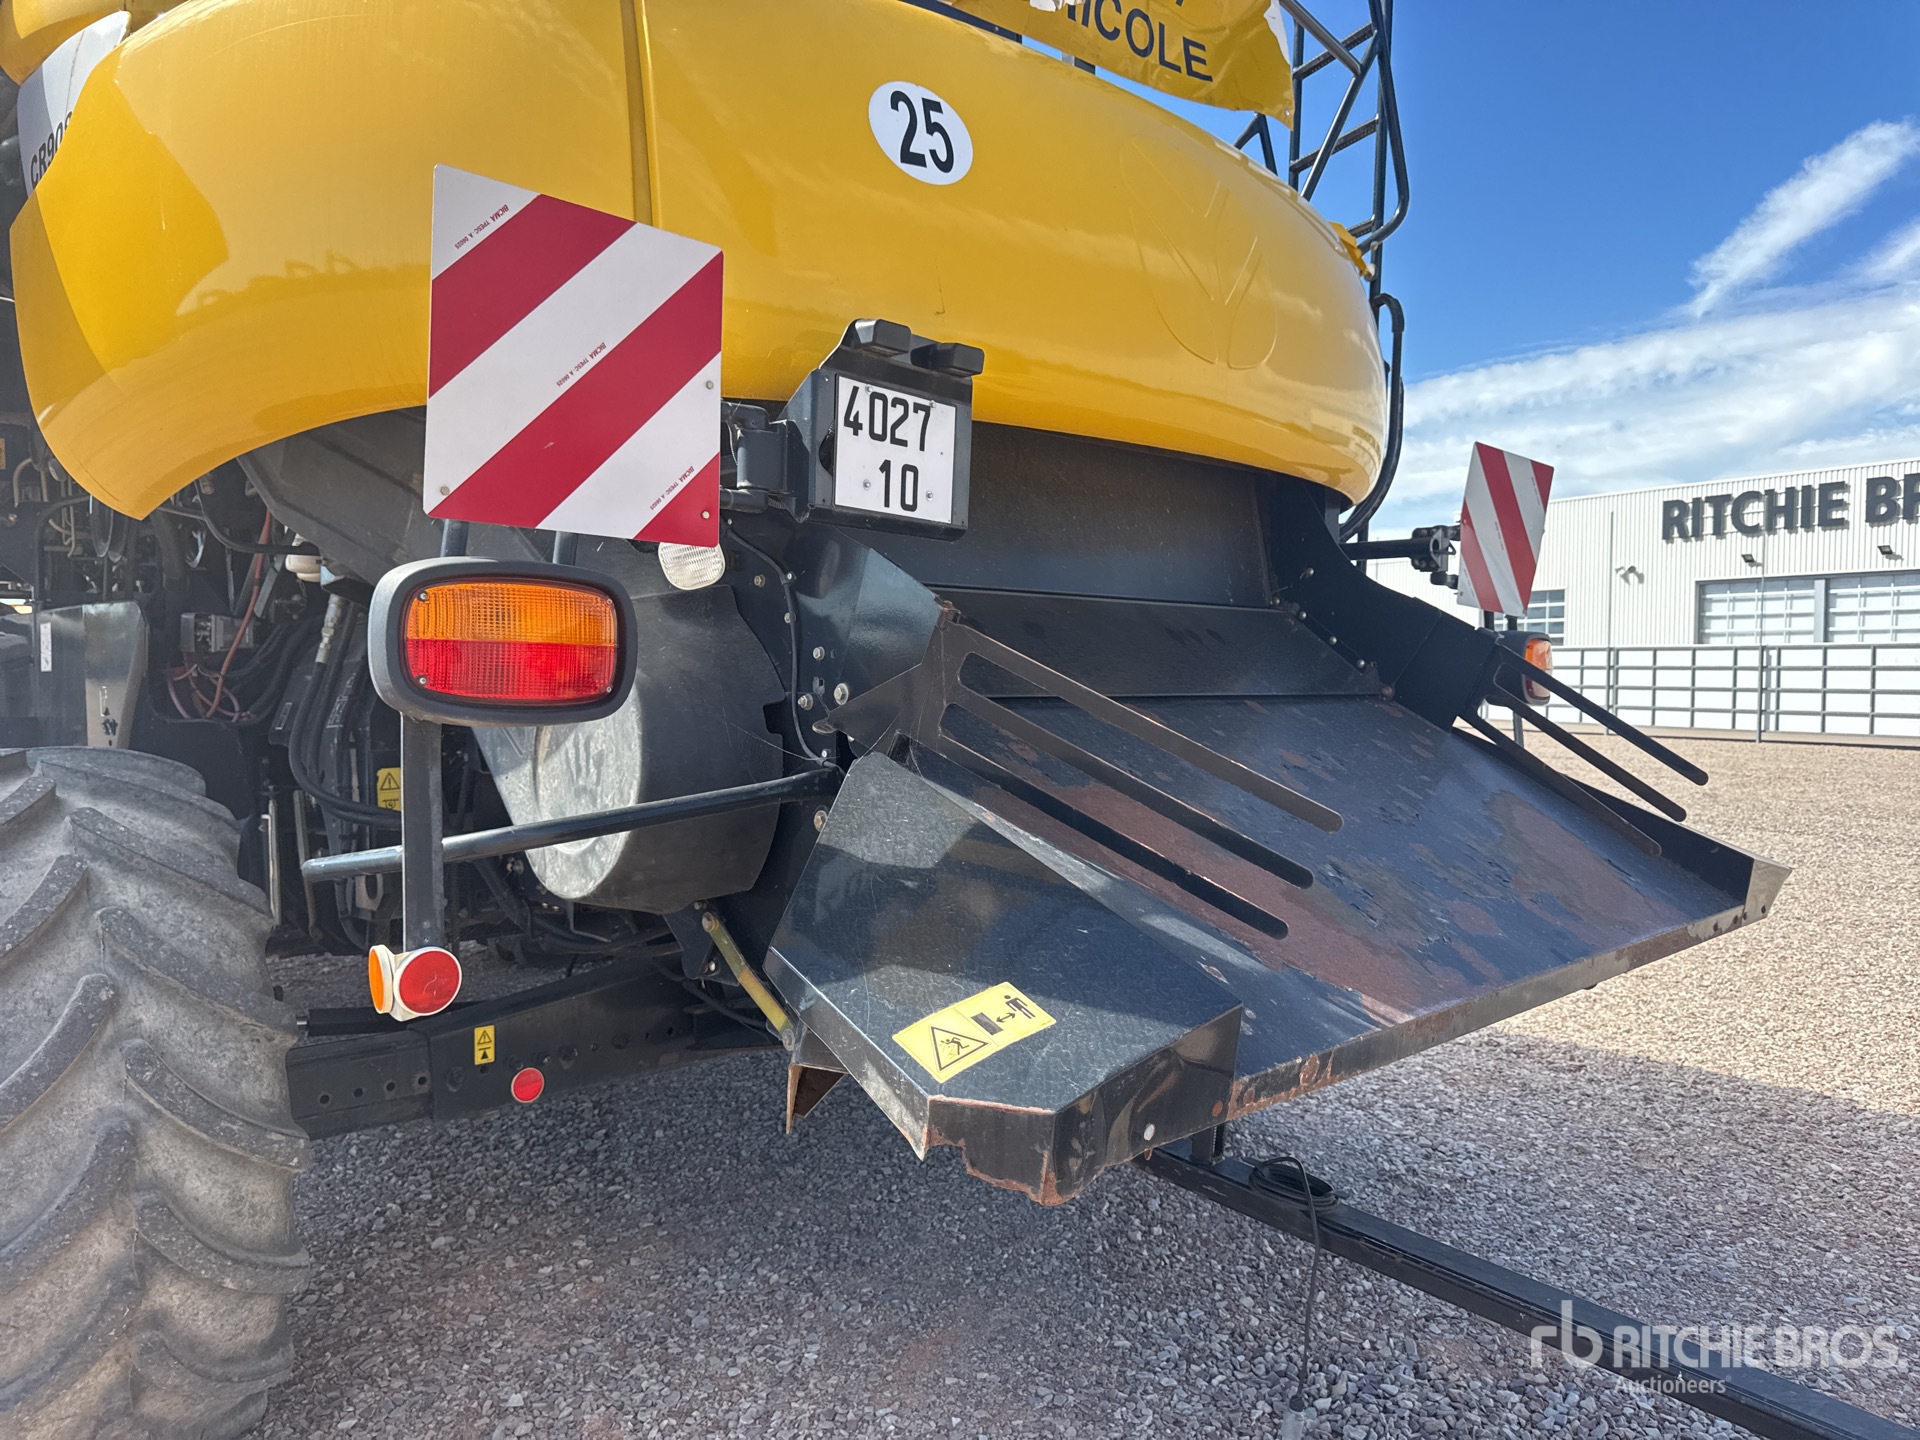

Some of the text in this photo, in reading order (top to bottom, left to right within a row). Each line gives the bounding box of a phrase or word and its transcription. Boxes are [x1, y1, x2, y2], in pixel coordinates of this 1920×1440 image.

[1067, 0, 1213, 82] ICOLE
[890, 90, 954, 173] 25
[490, 204, 509, 222] BICMA
[589, 342, 607, 359] BICMA
[843, 385, 931, 452] 4027
[878, 459, 919, 512] 10
[1662, 481, 1846, 541] RITCHIE
